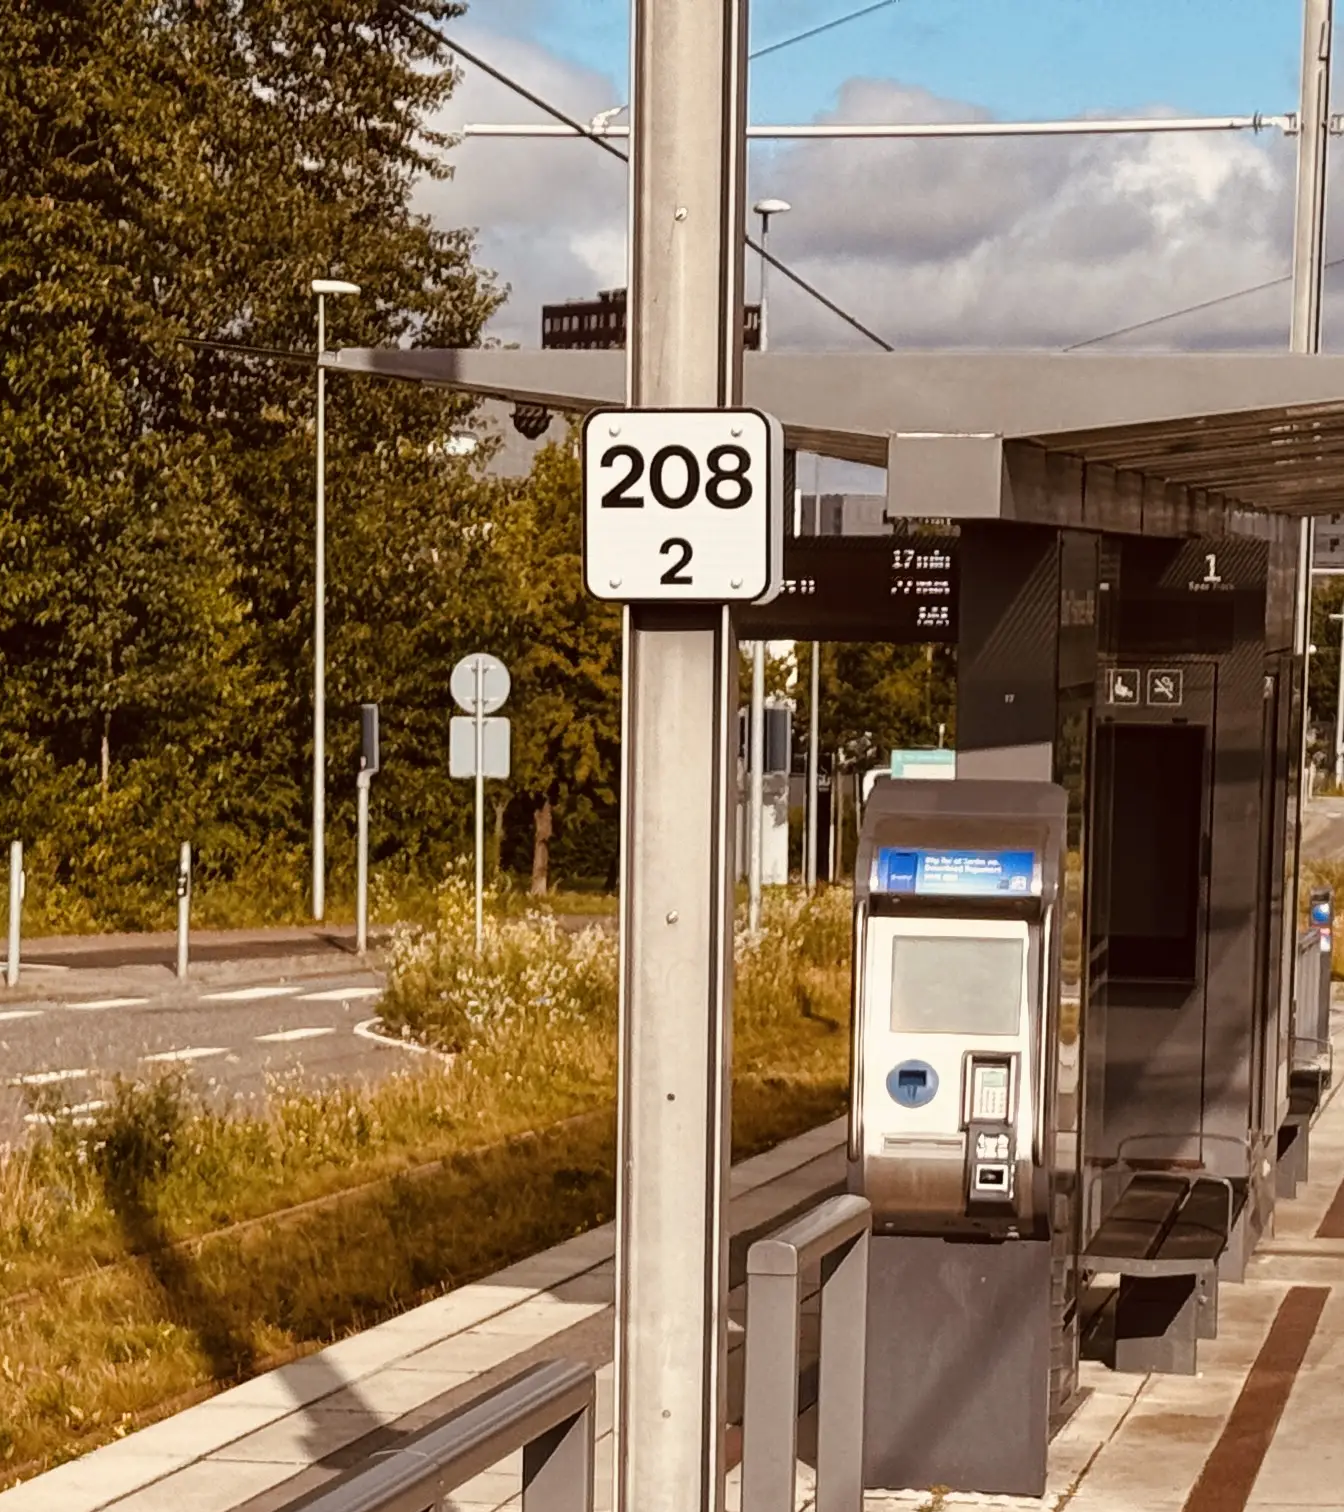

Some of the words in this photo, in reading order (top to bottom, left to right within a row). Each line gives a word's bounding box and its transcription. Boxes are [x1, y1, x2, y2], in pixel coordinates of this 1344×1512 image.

[600, 444, 753, 509] 208
[659, 537, 693, 585] 2
[1203, 553, 1222, 582] 1
